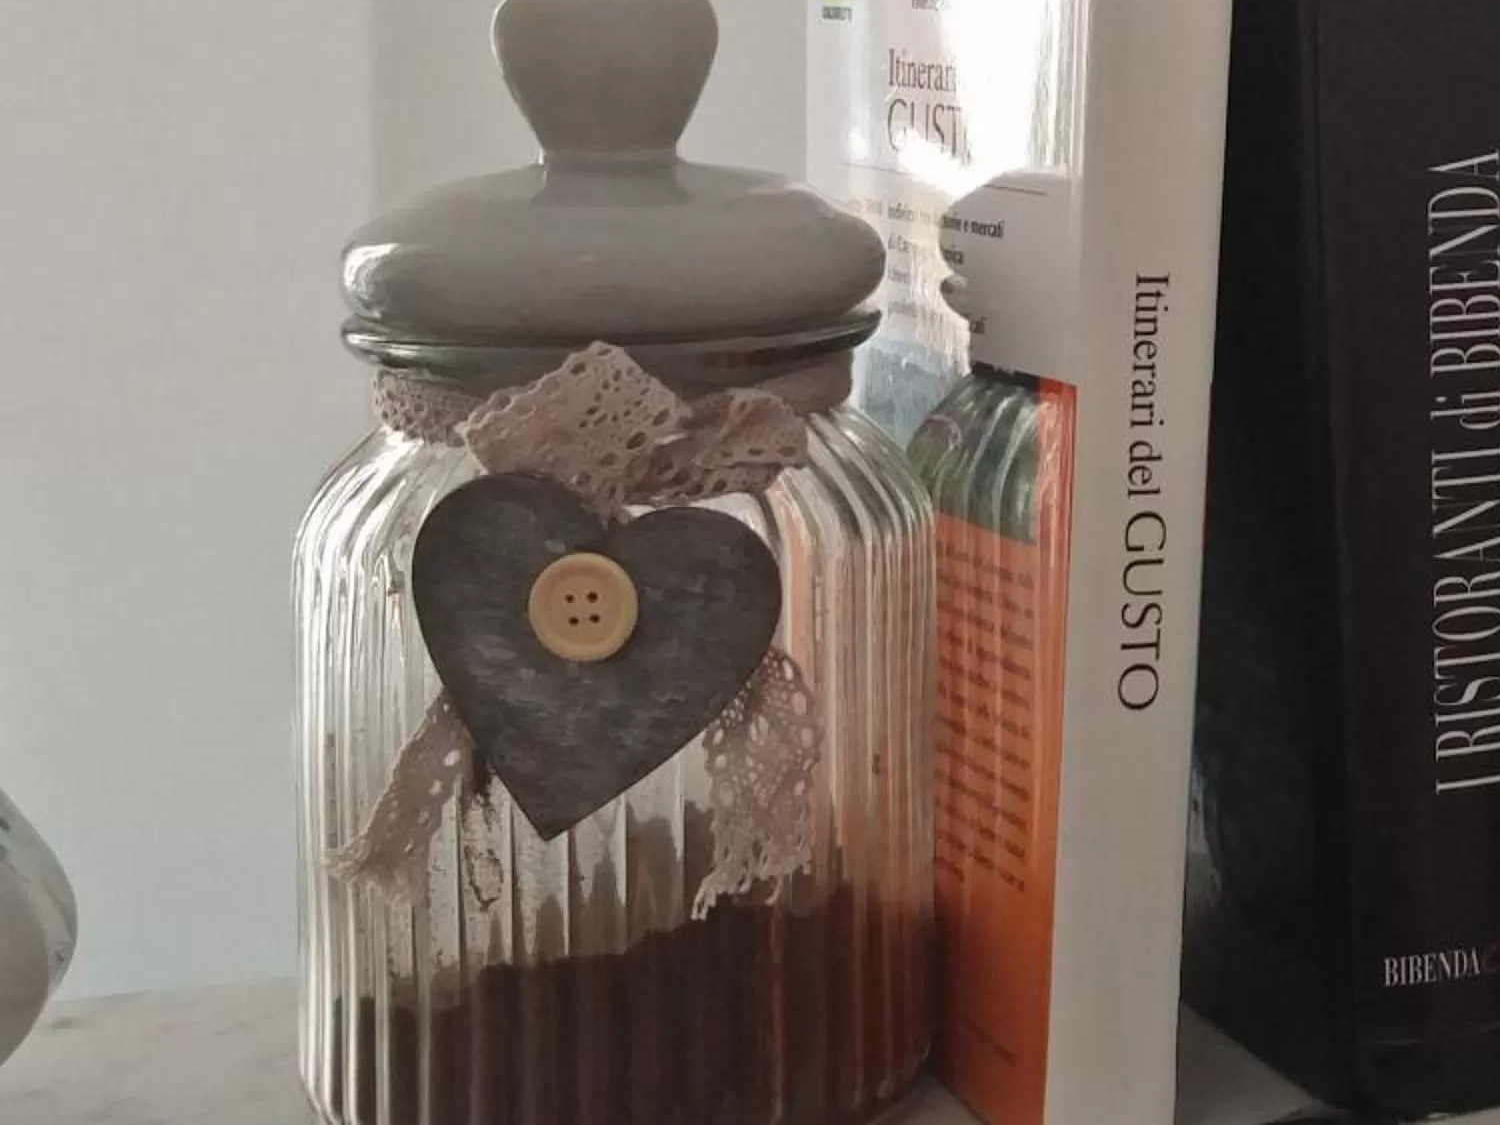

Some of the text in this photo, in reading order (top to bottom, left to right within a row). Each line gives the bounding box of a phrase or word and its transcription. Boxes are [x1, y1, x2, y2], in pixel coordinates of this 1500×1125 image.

[1116, 272, 1171, 712] Itinerari del GUSTO
[1383, 946, 1481, 988] BIBENDA
